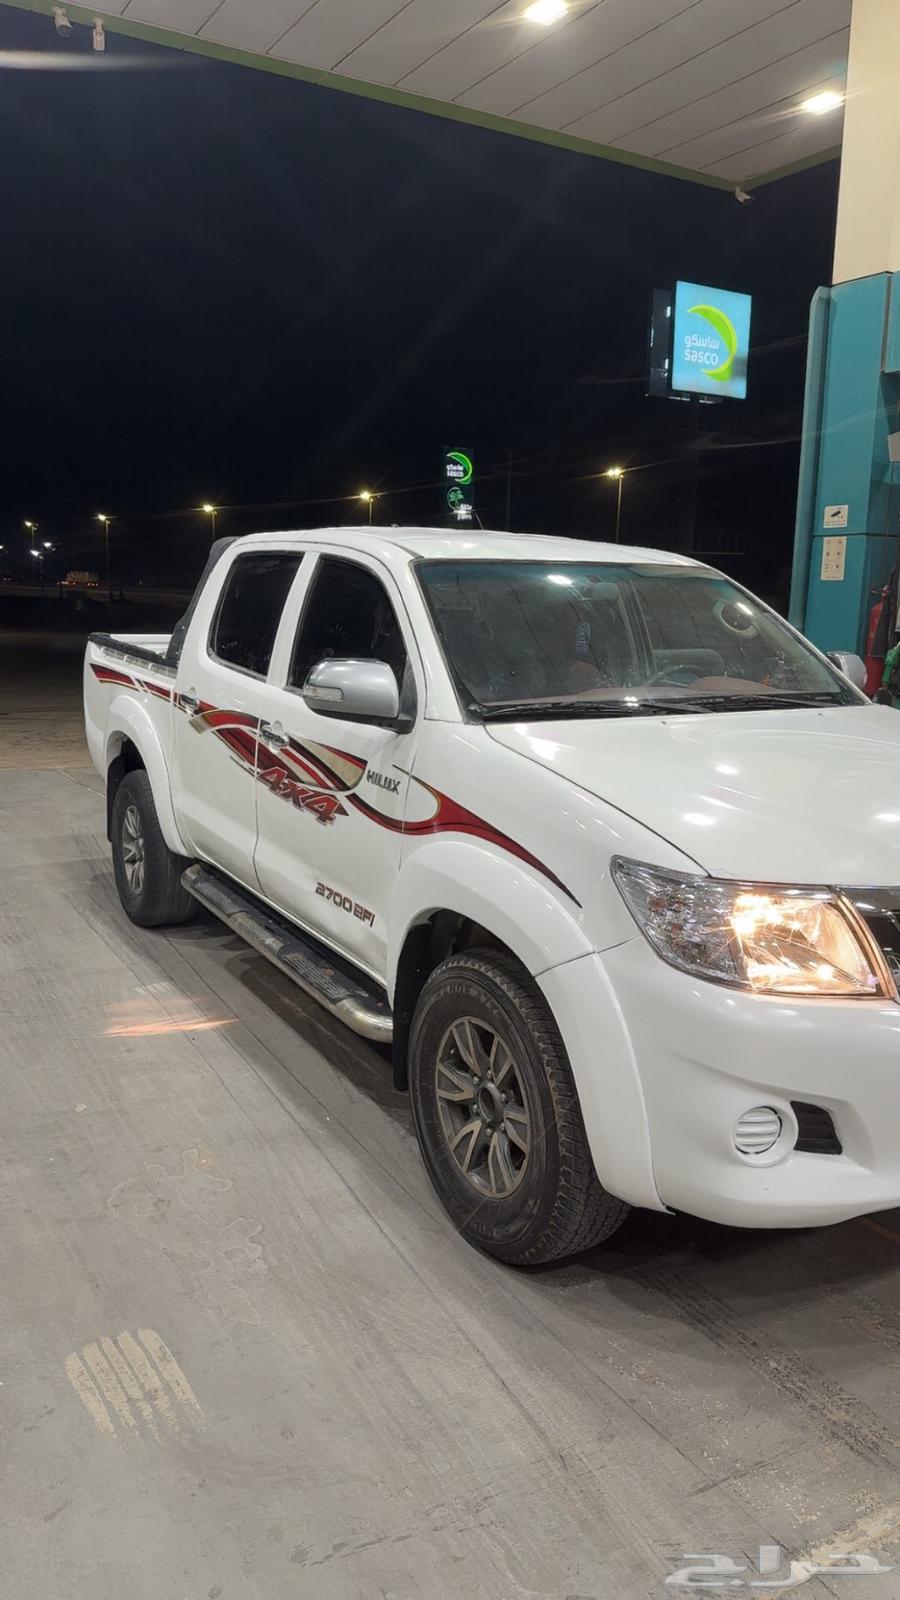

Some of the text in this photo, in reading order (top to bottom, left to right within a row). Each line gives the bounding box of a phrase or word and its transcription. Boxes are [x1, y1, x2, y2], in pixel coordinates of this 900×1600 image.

[684, 334, 720, 350] ساسكو
[684, 349, 719, 365] sasco
[366, 769, 401, 795] HILUX
[315, 881, 376, 928] 2700 EFI
